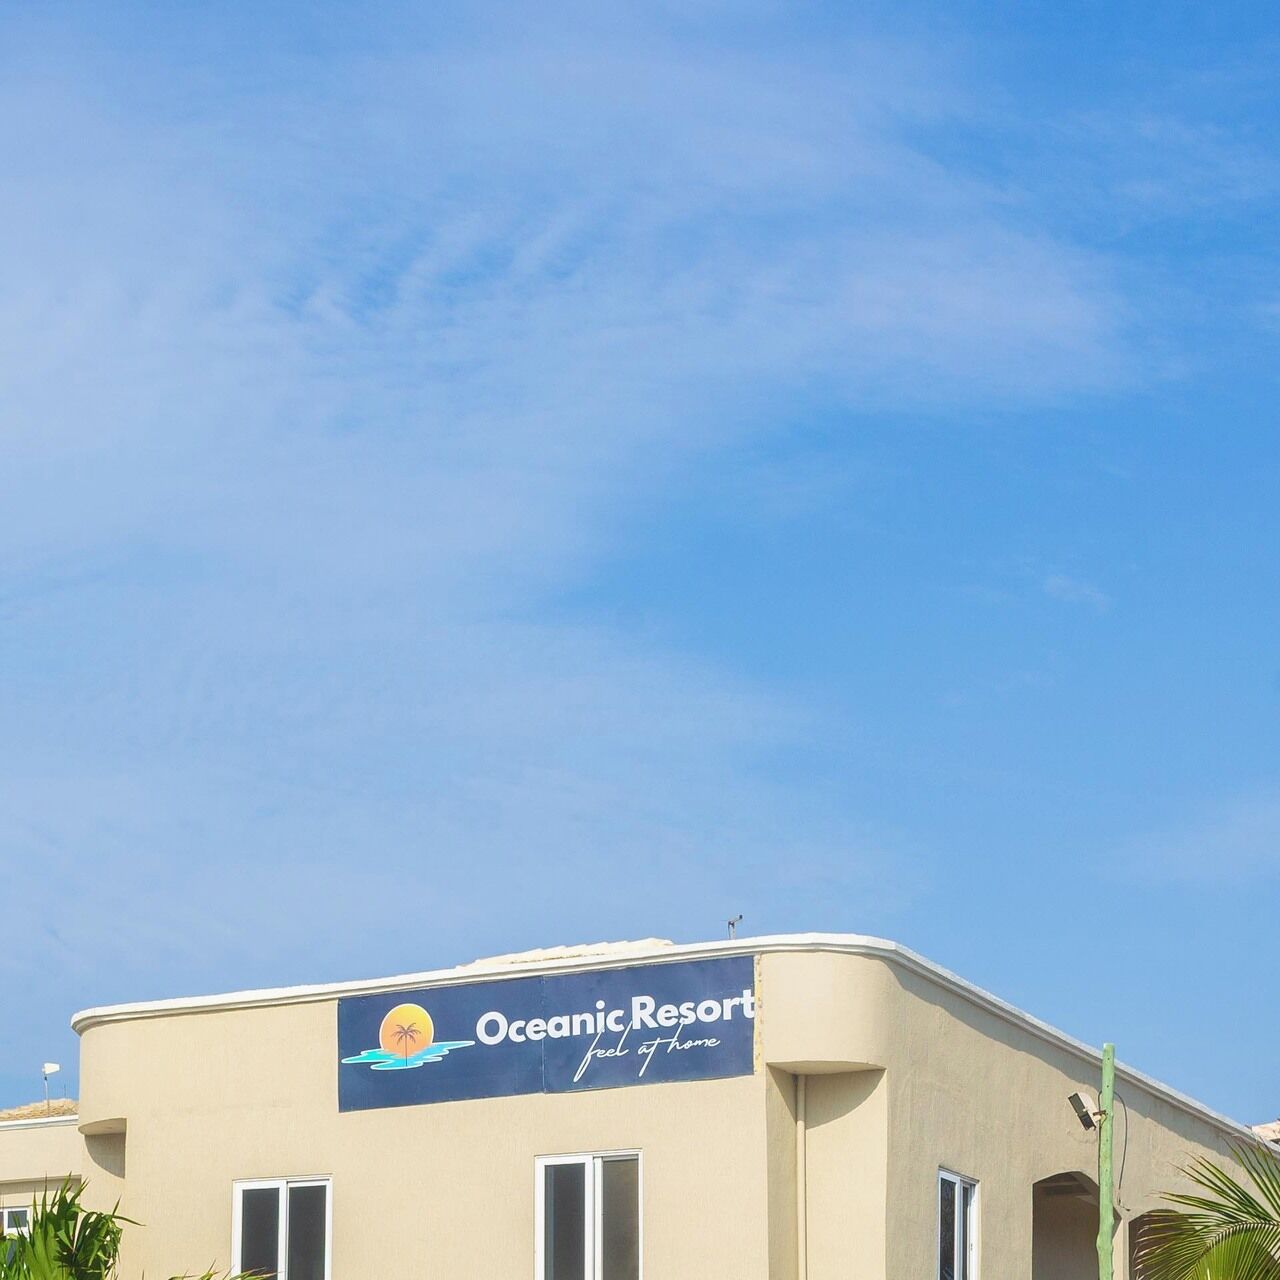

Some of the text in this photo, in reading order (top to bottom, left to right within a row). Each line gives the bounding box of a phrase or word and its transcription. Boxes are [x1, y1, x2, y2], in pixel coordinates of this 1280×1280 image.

[476, 989, 755, 1046] Oceanic Resort
[574, 1020, 721, 1082] feel at home
